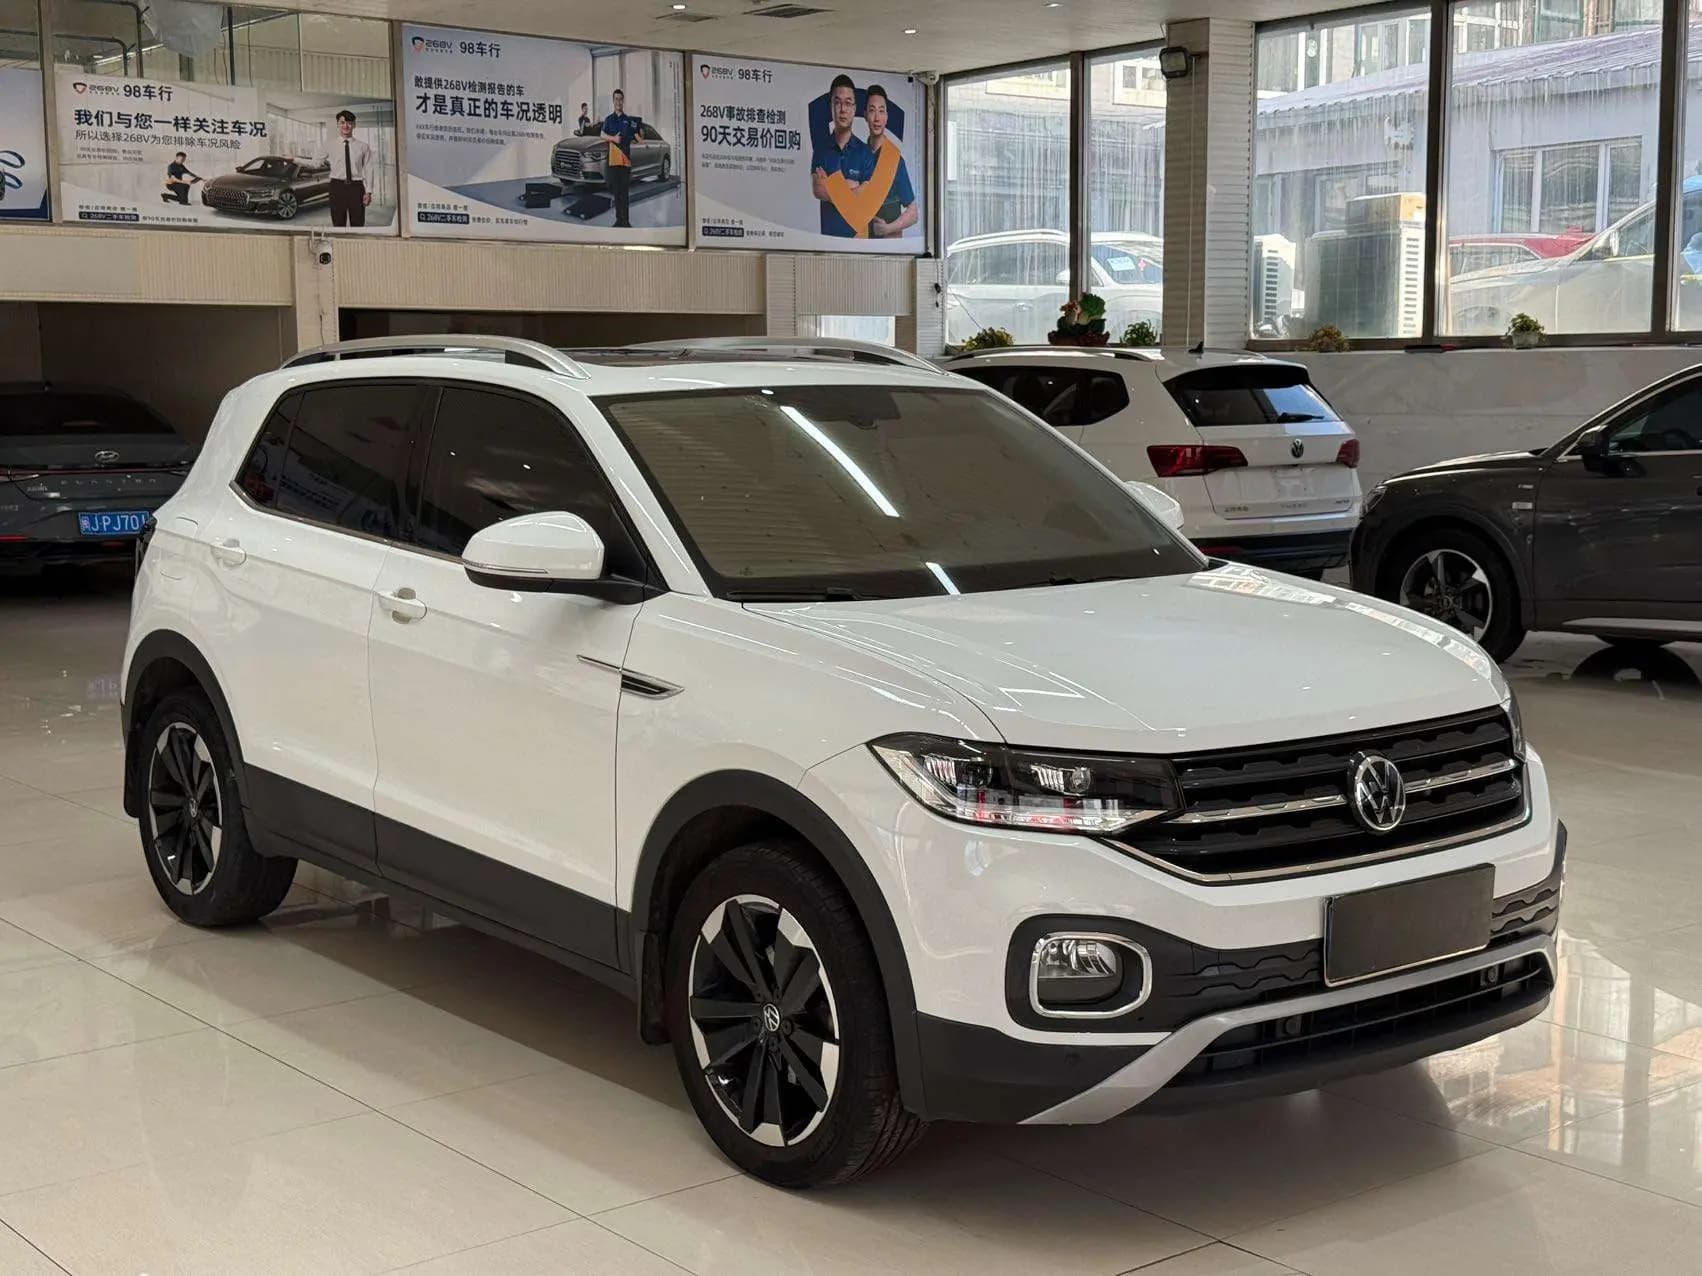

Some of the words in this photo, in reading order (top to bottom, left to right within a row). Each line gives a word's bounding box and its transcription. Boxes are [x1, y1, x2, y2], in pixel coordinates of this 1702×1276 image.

[425, 39, 453, 49] 268V
[459, 41, 501, 58] 98车行
[414, 75, 525, 97] 敢提供268V检测报告的车
[738, 68, 773, 83] 98车行
[123, 84, 174, 102] 98车行
[415, 92, 563, 125] 才是真正的车况透明
[700, 104, 786, 125] 268V事故排查检测
[74, 109, 268, 138] 我们与您一样关注车况
[75, 129, 242, 151] 所以选择268V为您排除车况风险
[701, 125, 801, 151] 90天交易价回购
[82, 513, 148, 532] J·PJ70
